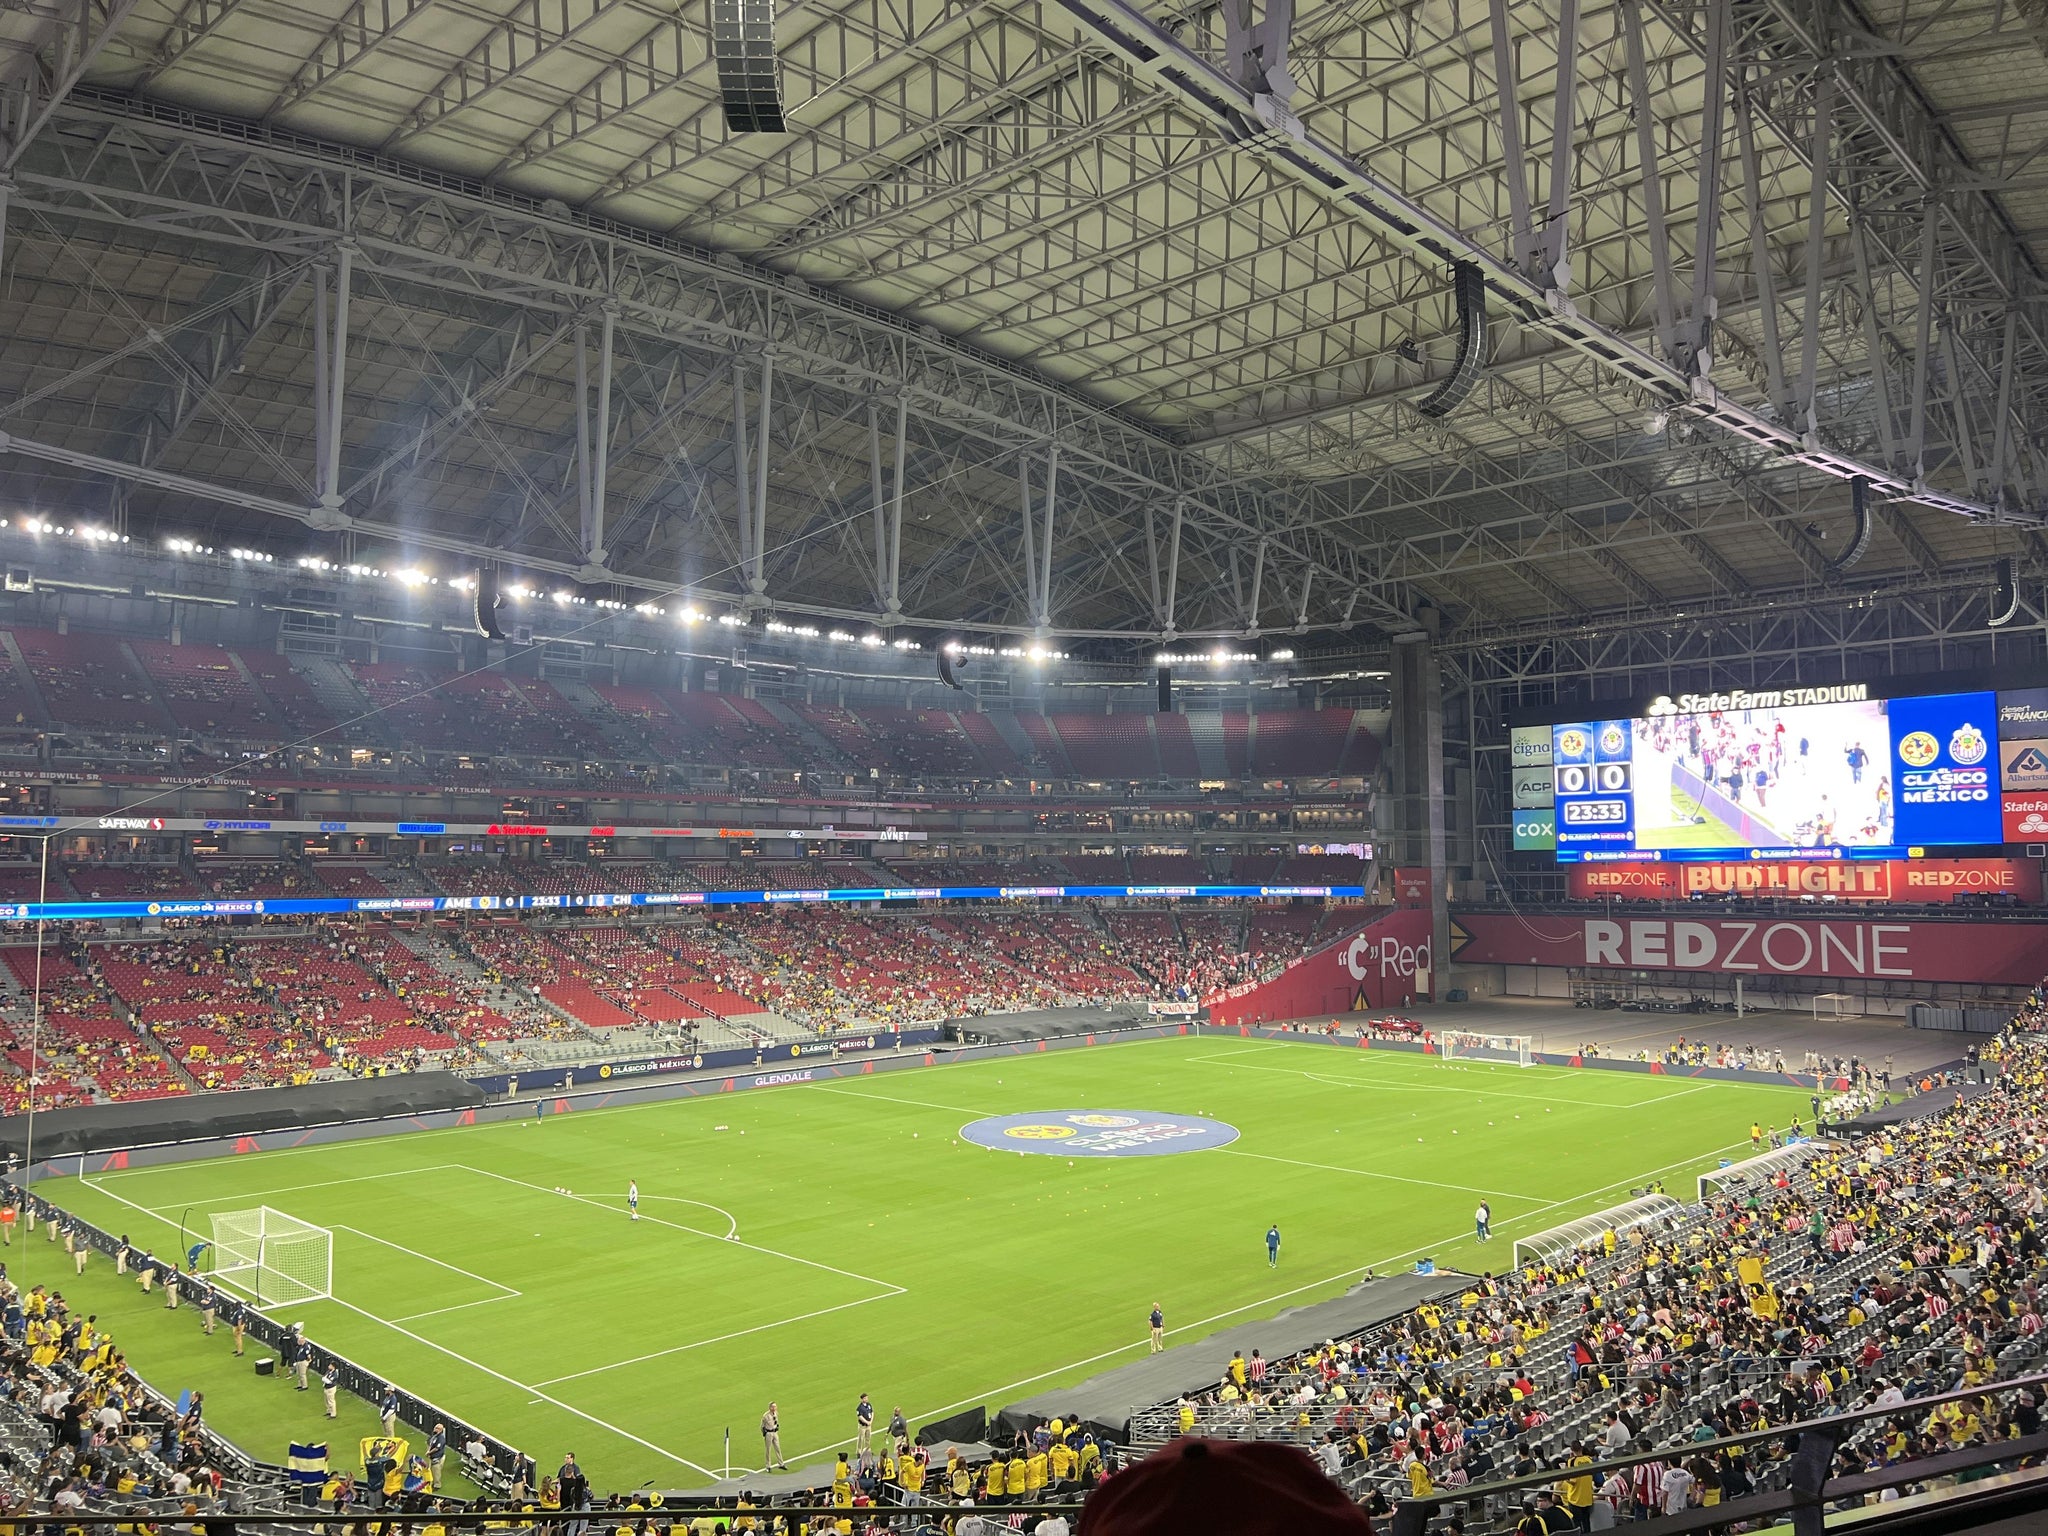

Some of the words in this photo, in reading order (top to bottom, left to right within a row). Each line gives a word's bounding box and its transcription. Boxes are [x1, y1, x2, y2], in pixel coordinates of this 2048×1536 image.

[1782, 683, 1867, 706] STADIUM
[2001, 705, 2030, 713] desert
[1513, 743, 1550, 757] cigna
[160, 776, 201, 785] WILLIAM
[1564, 768, 1584, 791] 0
[1604, 766, 1624, 789] 0
[1903, 772, 1988, 786] CLÁSICO
[1521, 783, 1552, 792] ACP
[1903, 789, 1988, 803] MÉXICO
[1569, 805, 1622, 821] 23:33
[99, 818, 150, 829] SAFEWAY
[320, 822, 347, 832] COX
[1516, 823, 1553, 837] COX
[880, 831, 909, 840] AVNET
[1687, 866, 1763, 891] BUD
[1767, 865, 1882, 892] LIGHT
[444, 898, 472, 909] AME
[532, 895, 561, 906] 23:33
[612, 894, 631, 905] CHI
[1381, 935, 1431, 977] Red
[801, 1044, 828, 1053] CLÁSICO
[840, 1040, 866, 1049] MÉXICO
[612, 1065, 646, 1074] CLÁSICO
[659, 1059, 692, 1069] MÉXICO
[755, 1071, 812, 1086] GLENDALE
